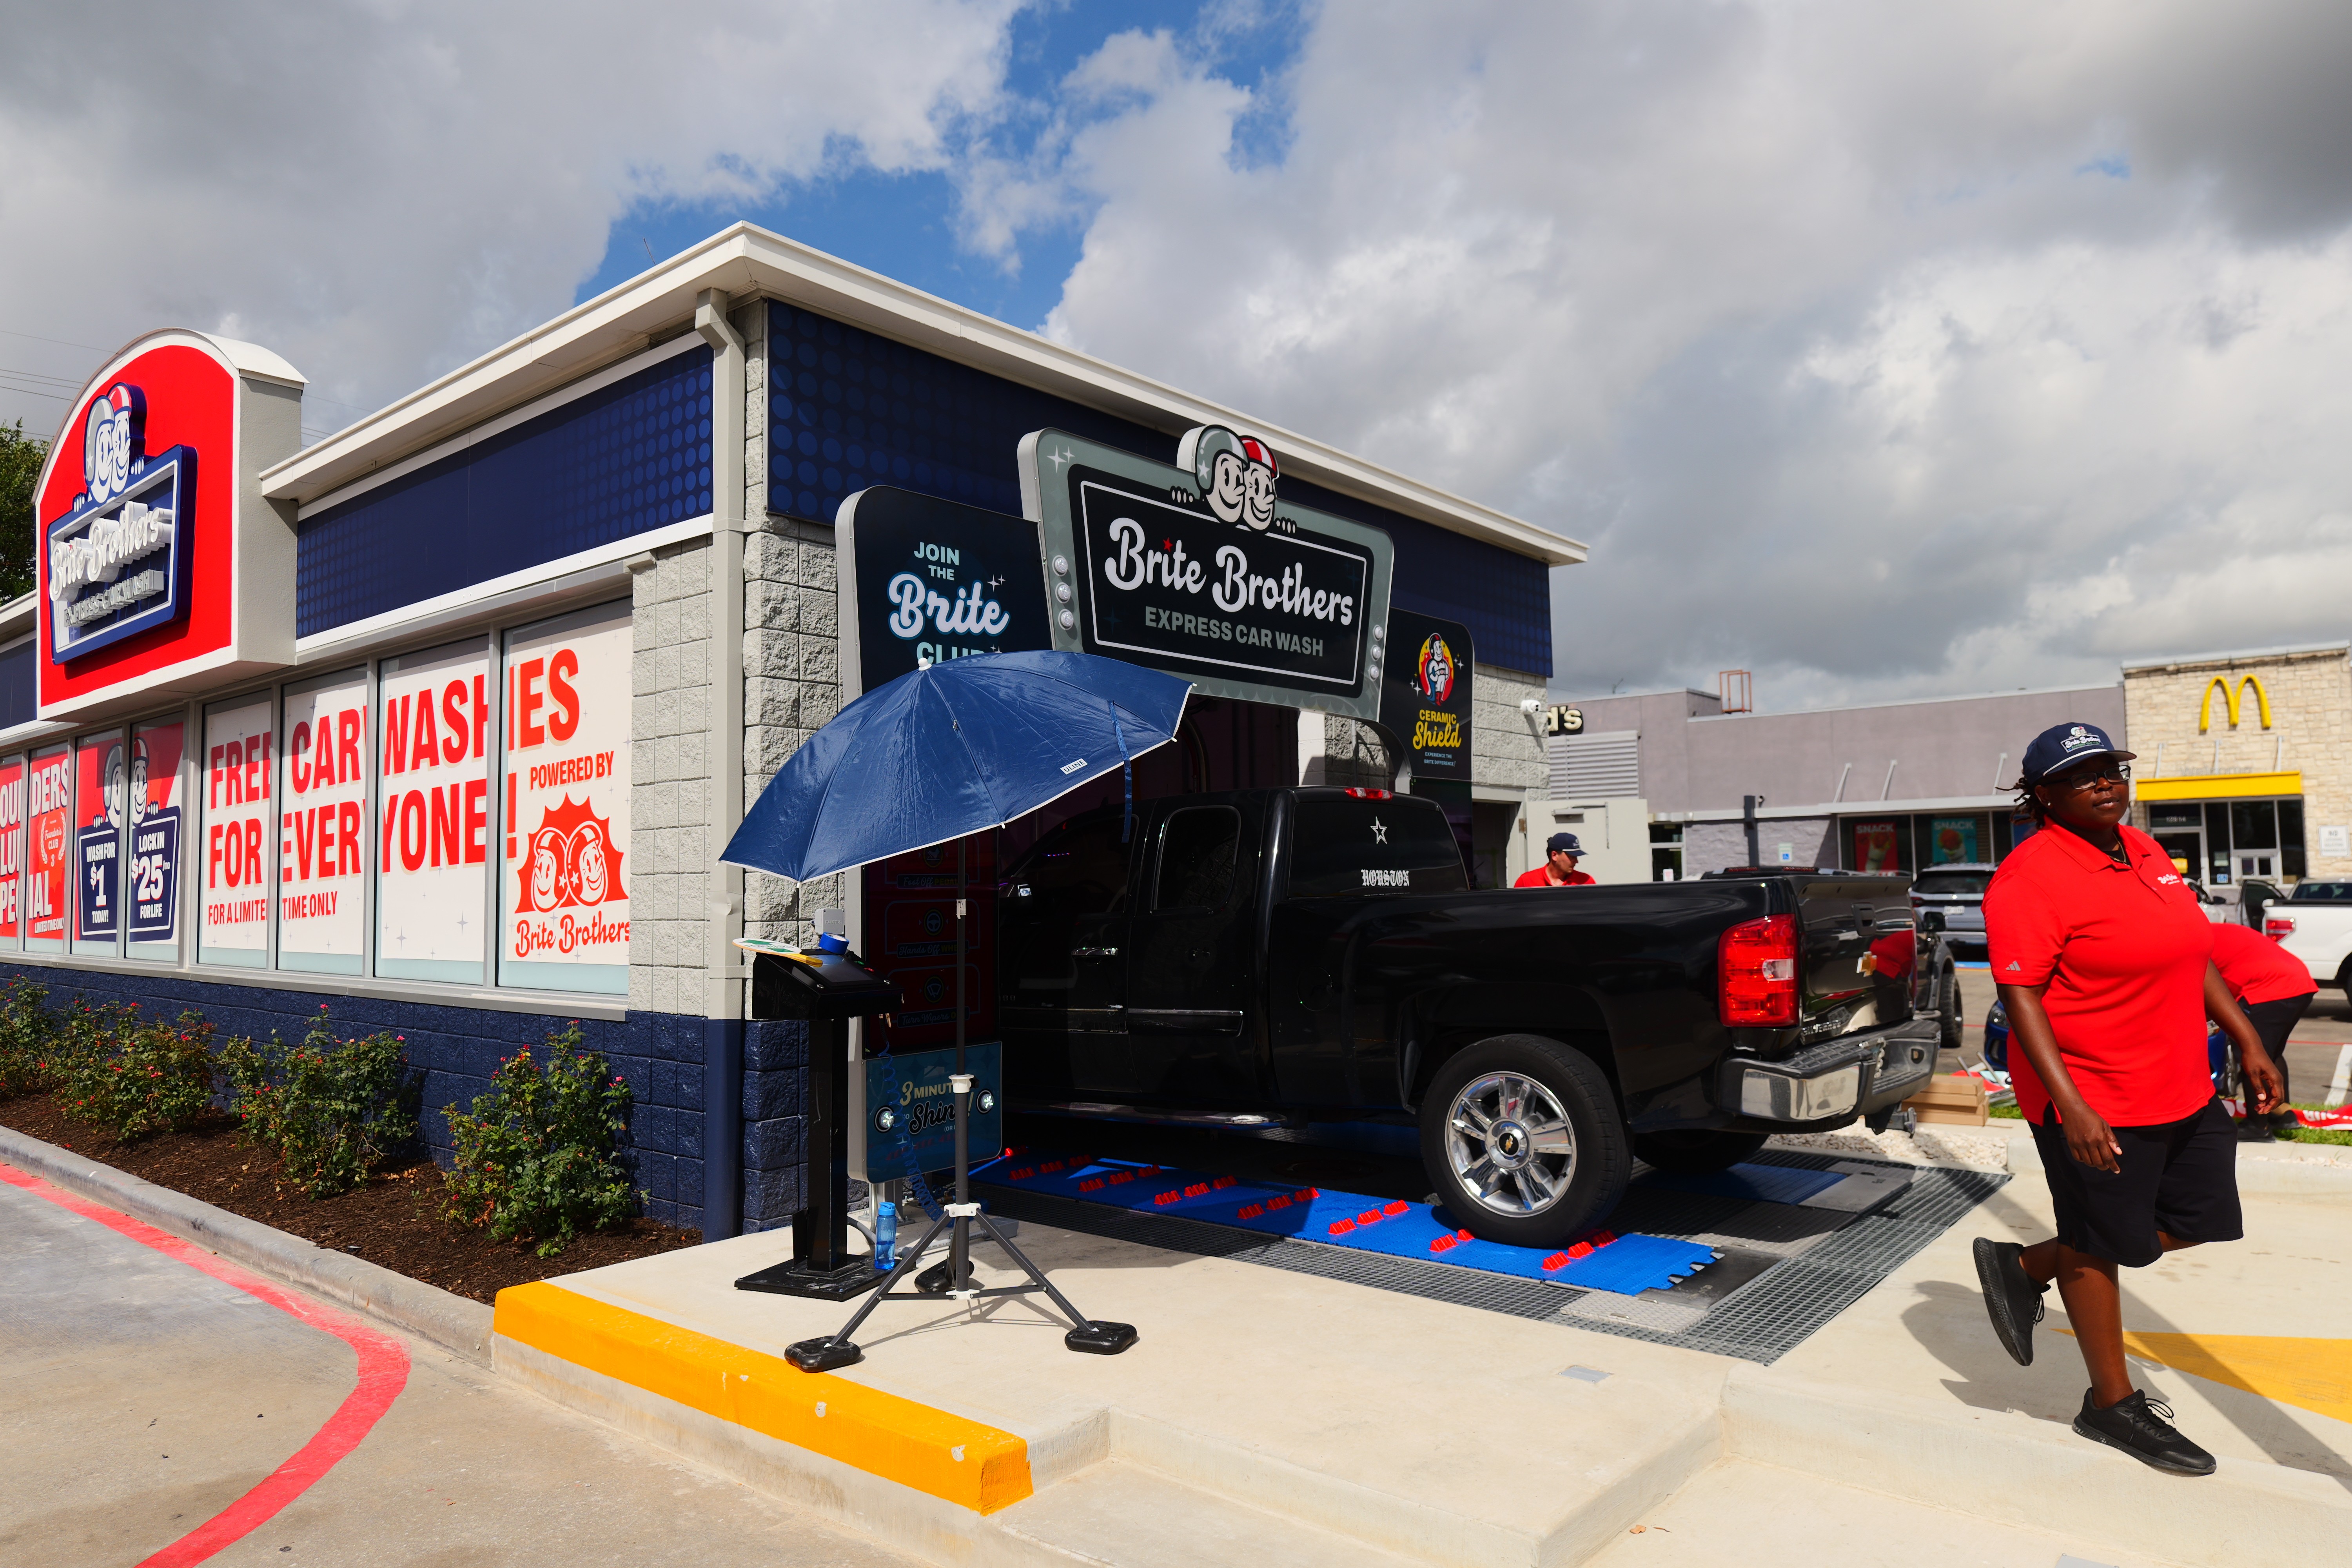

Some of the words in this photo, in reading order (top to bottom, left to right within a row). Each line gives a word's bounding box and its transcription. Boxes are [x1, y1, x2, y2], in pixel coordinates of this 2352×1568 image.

[914, 542, 959, 566] JOIN
[928, 564, 955, 581] THE
[1105, 517, 1207, 594] Brite
[1212, 545, 1353, 625] Brothers
[64, 593, 103, 627] EXPRESS
[102, 583, 123, 610] CAR
[122, 569, 154, 600] WASH
[888, 572, 1010, 639] Brite
[1145, 606, 1231, 641] EXPRESS
[1236, 624, 1272, 648] CAR
[1275, 631, 1323, 657] WASH
[1419, 710, 1457, 724] CERAMIC
[210, 731, 271, 810] FREE
[292, 709, 361, 794] CAR
[363, 649, 579, 776] WASHES
[1413, 721, 1462, 750] Shield
[530, 756, 593, 790] POWERED
[596, 751, 614, 778] BY
[1063, 760, 1085, 772] ULINE
[1856, 824, 1895, 834] SNACK
[48, 838, 58, 850] CLUB
[86, 844, 103, 862] WASH
[103, 842, 116, 859] FOR
[139, 833, 157, 853] LOCK
[157, 831, 165, 849] IN
[210, 818, 262, 889] FOR
[90, 862, 107, 907] $1
[904, 877, 920, 886] Foot
[920, 877, 934, 887] Off
[1361, 869, 1409, 886] HOUSTON
[92, 909, 109, 924] TODAY!
[140, 905, 151, 919] FOR
[151, 903, 162, 917] LIFE
[209, 904, 225, 926] FOR
[227, 903, 232, 924] A
[282, 895, 307, 920] TIME
[310, 891, 338, 917] ONLY
[34, 920, 47, 934] LIMITED
[47, 918, 56, 931] TIME
[515, 920, 556, 958] Brite
[559, 911, 630, 954] Brothers
[899, 945, 927, 955] Hands
[927, 944, 940, 955] Off
[902, 1015, 921, 1025] Turn
[921, 1013, 950, 1024] Wipers
[900, 1081, 913, 1106] 3
